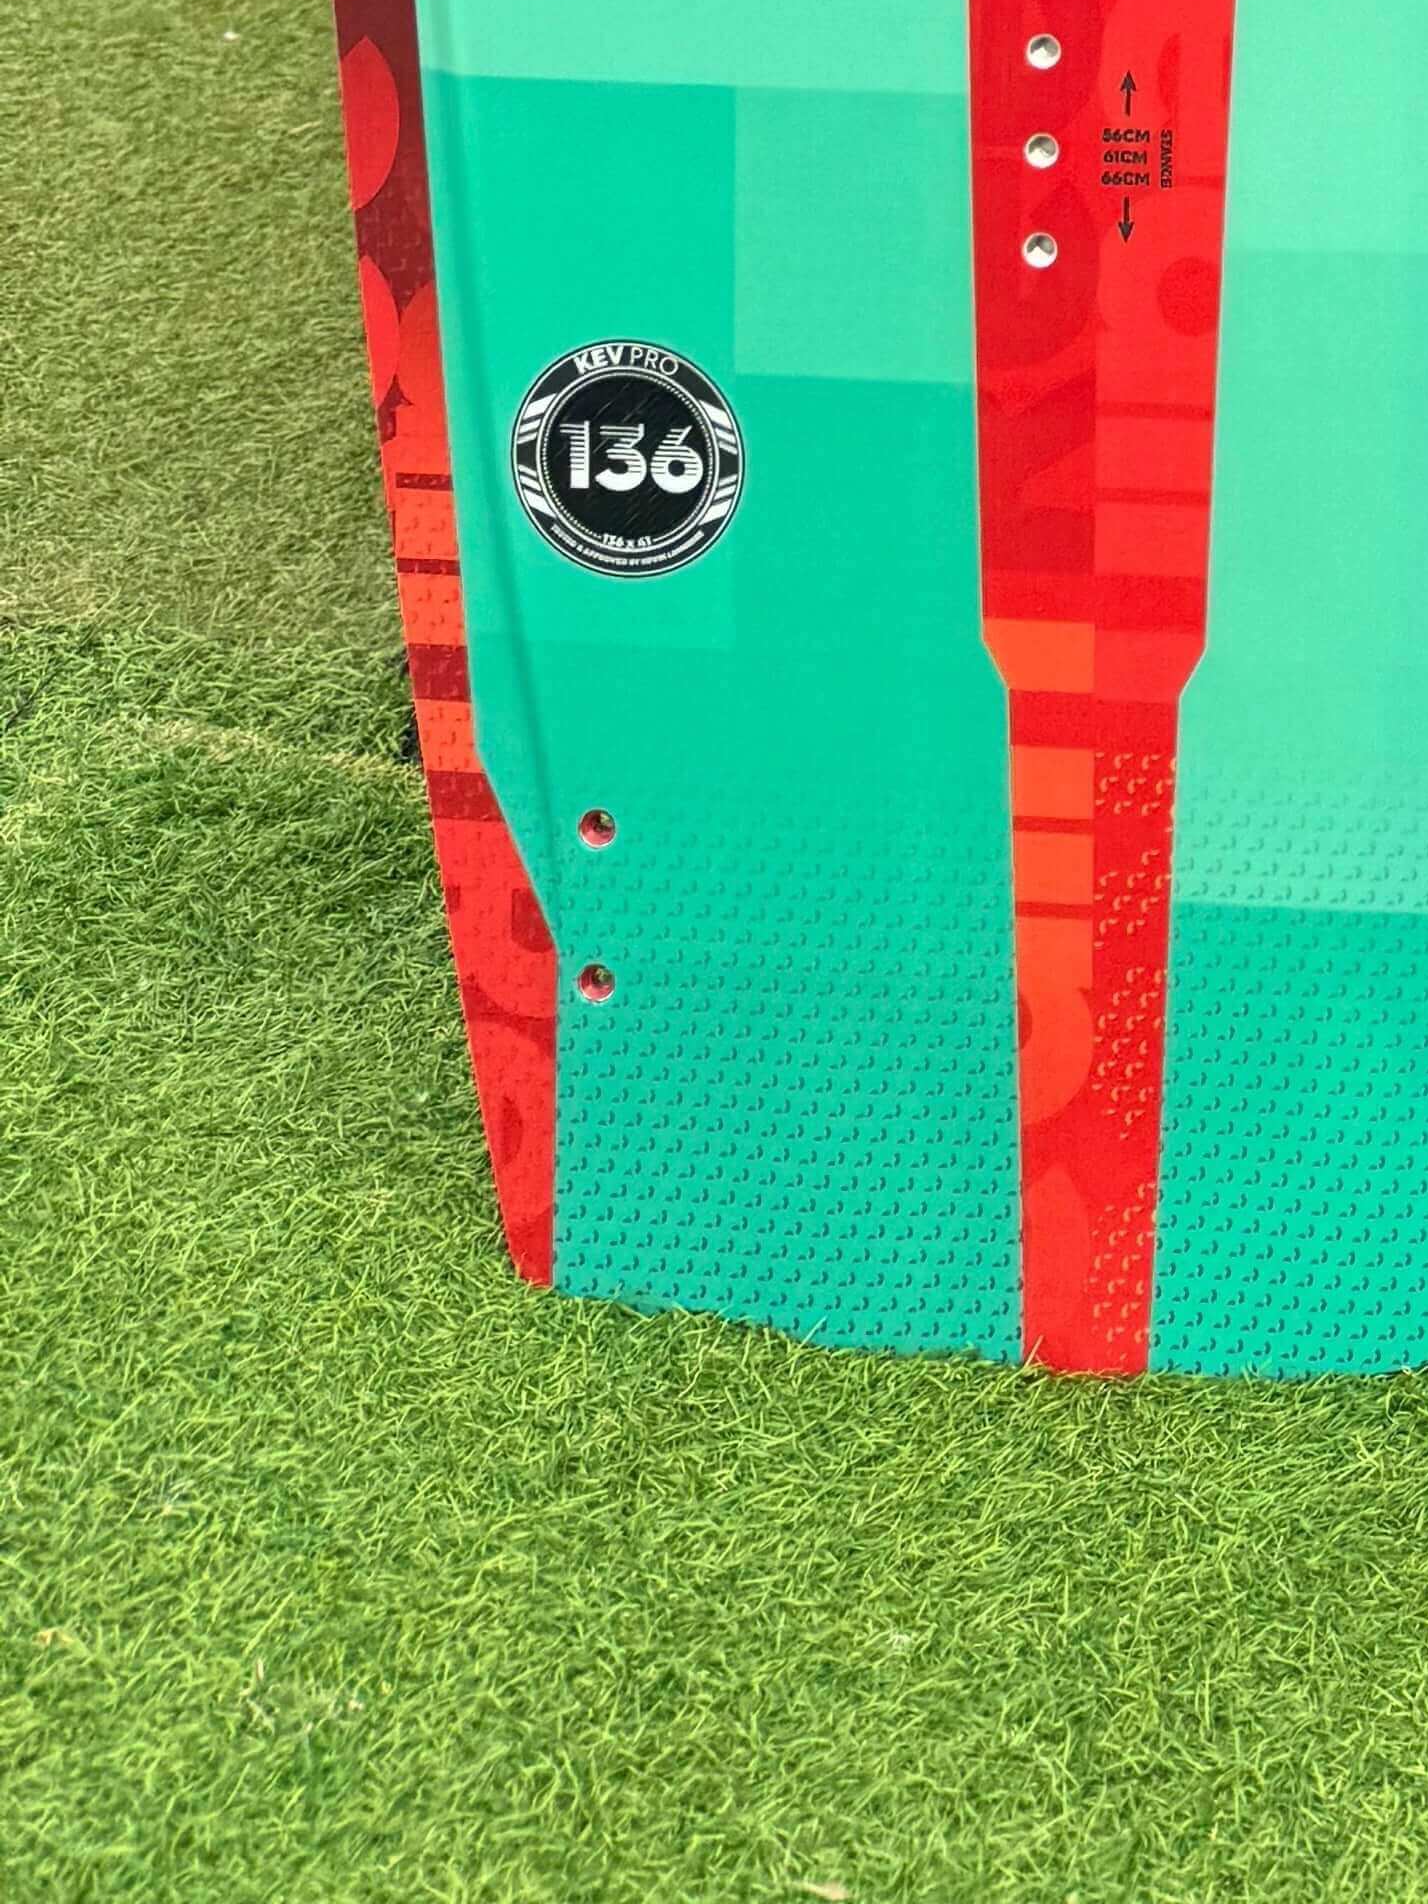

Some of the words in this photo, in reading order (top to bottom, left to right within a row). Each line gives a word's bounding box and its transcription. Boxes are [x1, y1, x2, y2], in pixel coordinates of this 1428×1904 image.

[1102, 128, 1150, 143] 56CM
[1103, 150, 1148, 165] 61CM
[1161, 129, 1173, 188] STANCE
[1101, 171, 1150, 186] 66CM
[559, 420, 704, 494] 136
